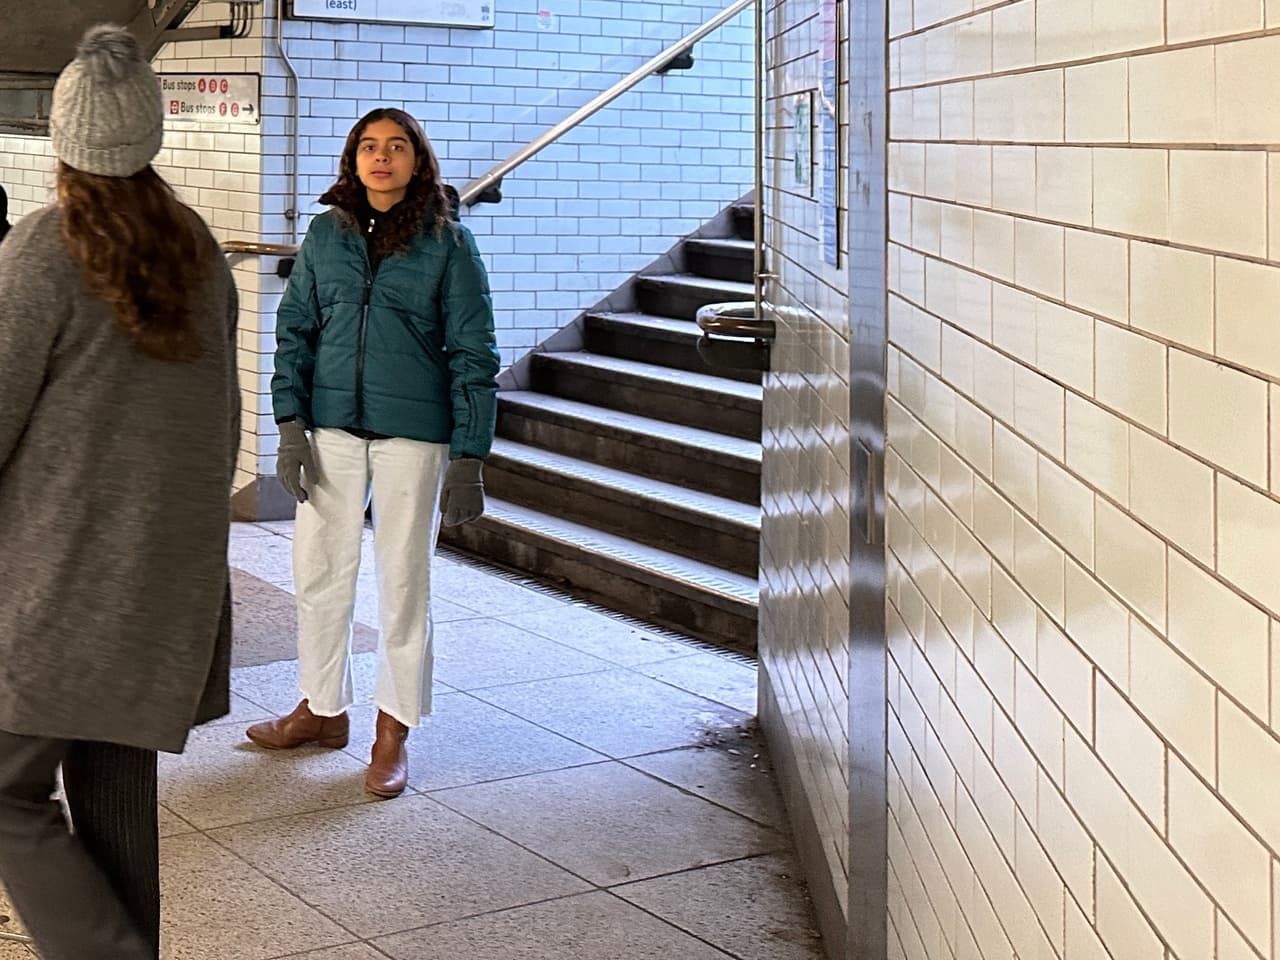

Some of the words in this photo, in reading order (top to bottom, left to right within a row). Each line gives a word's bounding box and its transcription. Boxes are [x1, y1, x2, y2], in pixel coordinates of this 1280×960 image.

[162, 79, 175, 90] Bus
[177, 79, 196, 92] stops
[181, 101, 194, 113] Bus
[195, 102, 216, 114] stops
